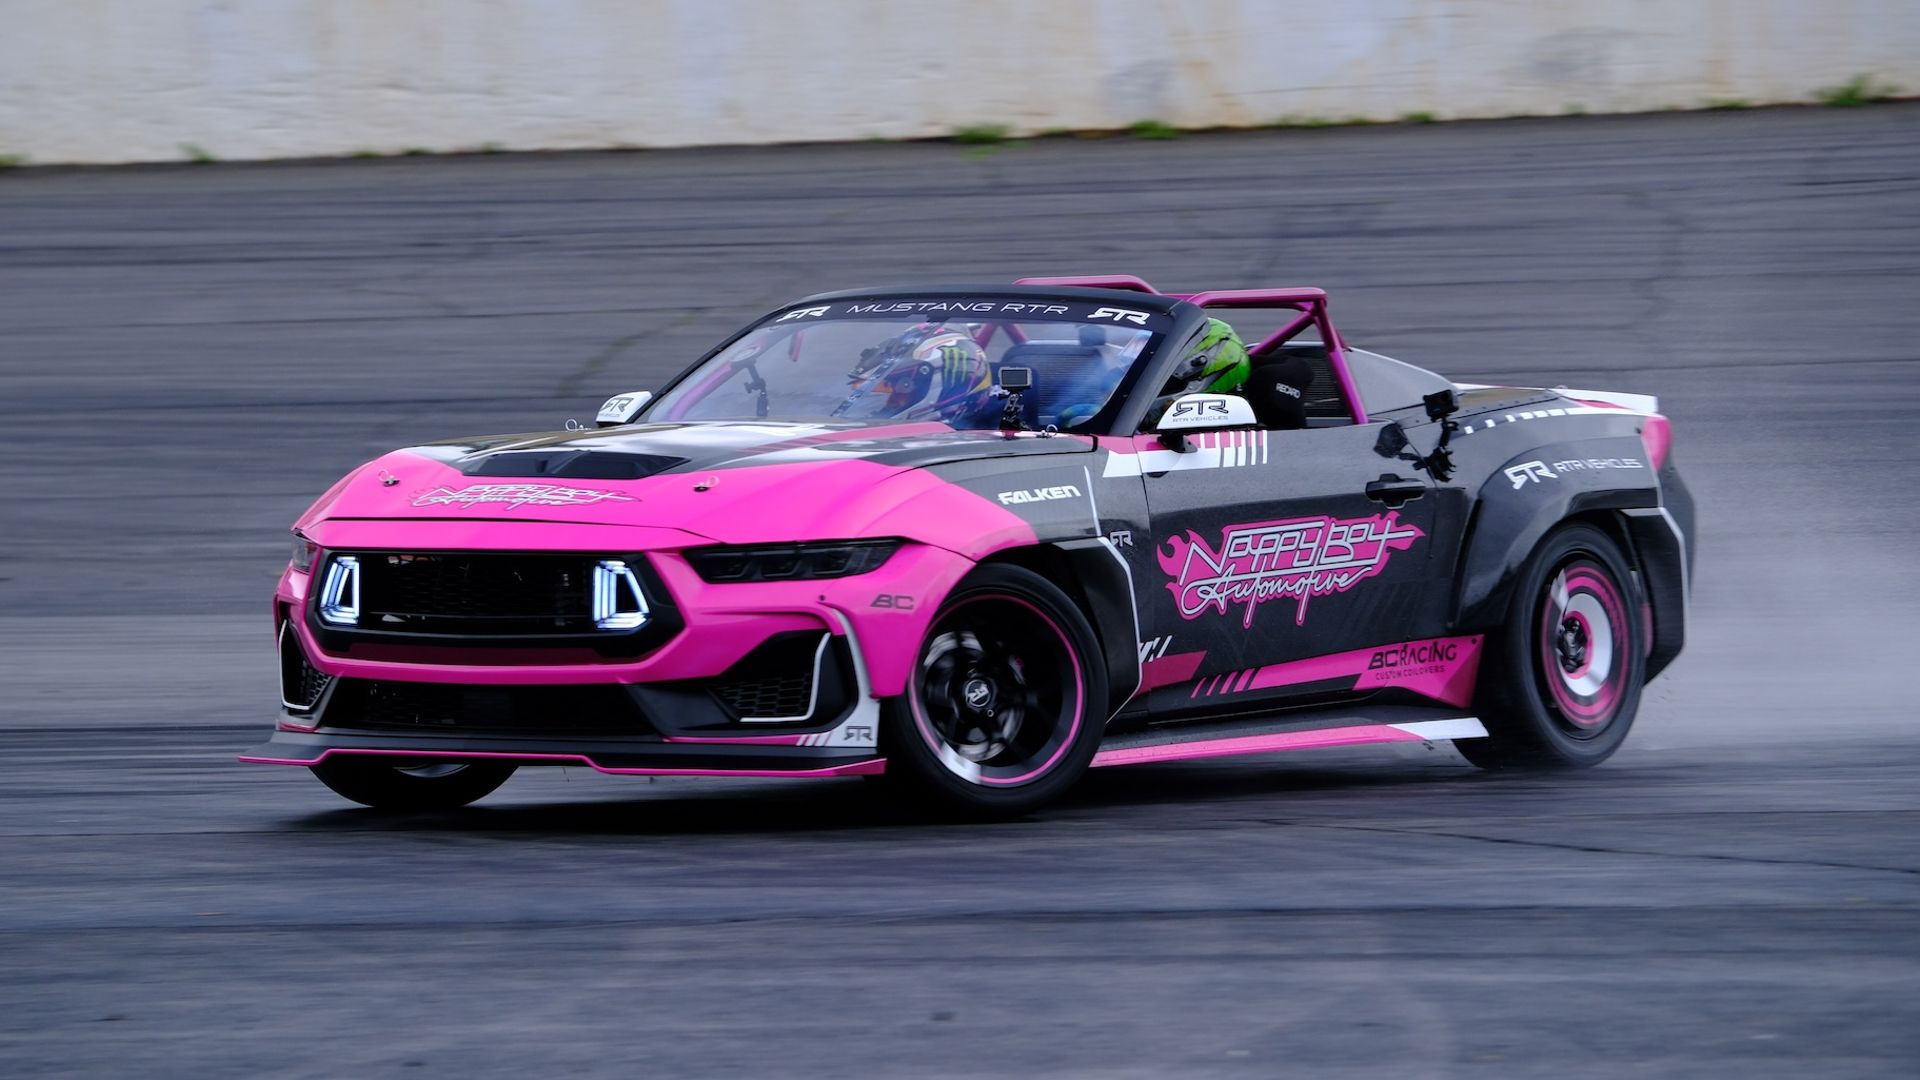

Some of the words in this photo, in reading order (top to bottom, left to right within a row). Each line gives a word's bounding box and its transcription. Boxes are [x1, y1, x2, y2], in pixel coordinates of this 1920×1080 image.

[846, 302, 996, 314] MUSTANG
[1000, 303, 1069, 314] RTR
[998, 485, 1082, 505] FALKEN
[870, 594, 914, 610] BC
